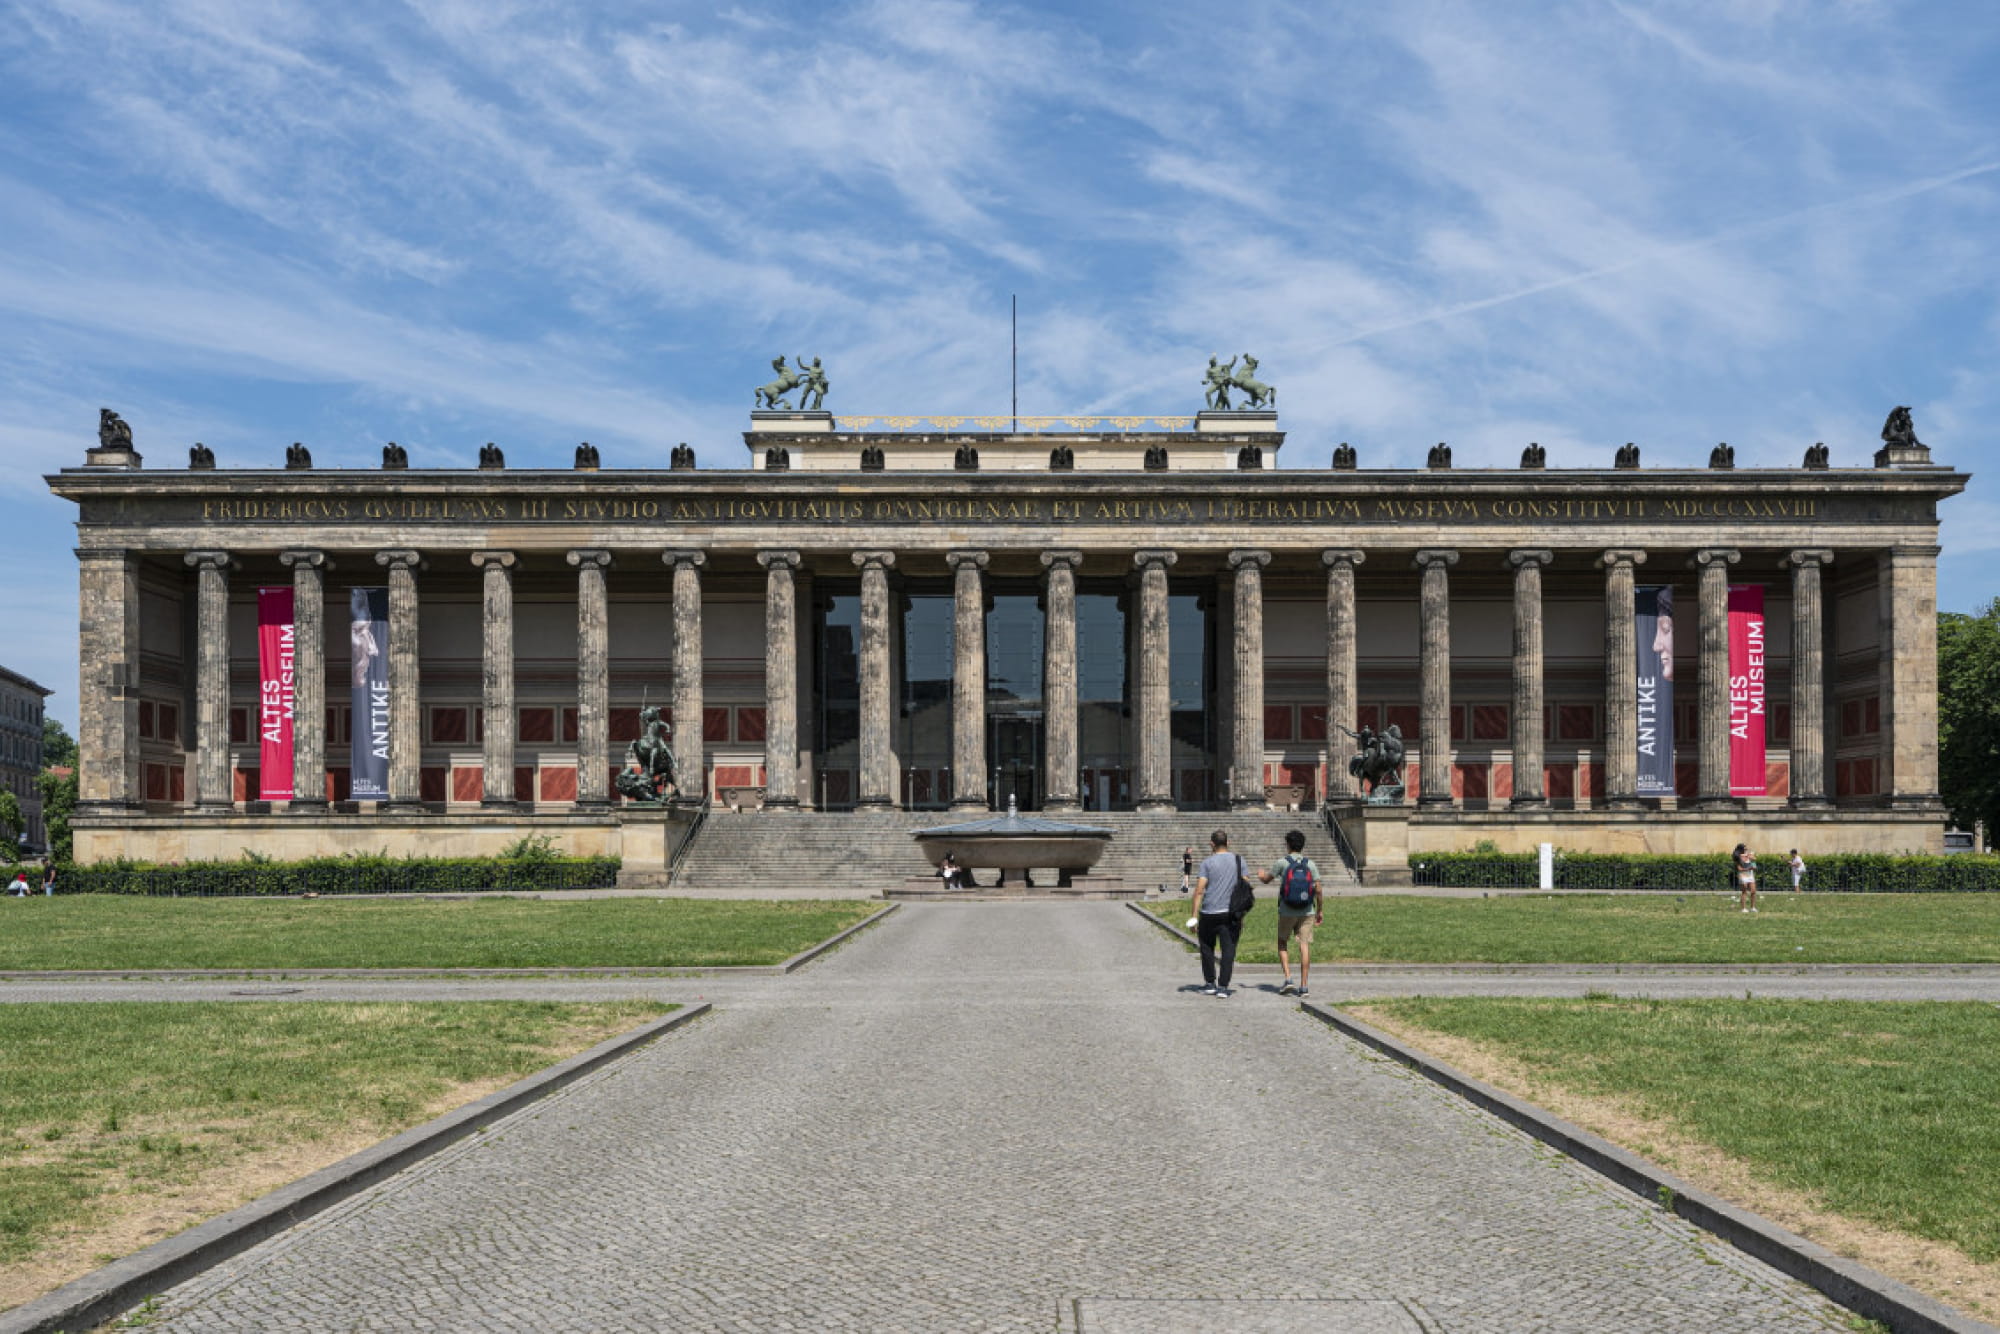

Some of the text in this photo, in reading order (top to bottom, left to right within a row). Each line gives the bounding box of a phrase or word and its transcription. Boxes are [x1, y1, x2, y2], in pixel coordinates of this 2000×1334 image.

[203, 501, 349, 518] FRIDERICVS
[520, 501, 548, 518] III
[563, 501, 658, 518] STVDIO
[673, 501, 863, 518] ANTIQVITATIS
[875, 501, 1040, 518] OMNIGENAE
[1053, 501, 1084, 518] ET
[1095, 501, 1194, 518] ARTIVM
[1207, 501, 1361, 518] LIBERALIVM
[1375, 500, 1480, 517] MVSEVM
[1492, 500, 1646, 517] CONSTITVIT
[1657, 500, 1815, 517] MDCCCXXVIII
[1747, 621, 1765, 714] MUSEUM
[262, 680, 282, 744] ALTES
[371, 680, 389, 760] ANTIKE
[1638, 676, 1656, 756] ANTIKE
[1729, 675, 1748, 740] ALTES
